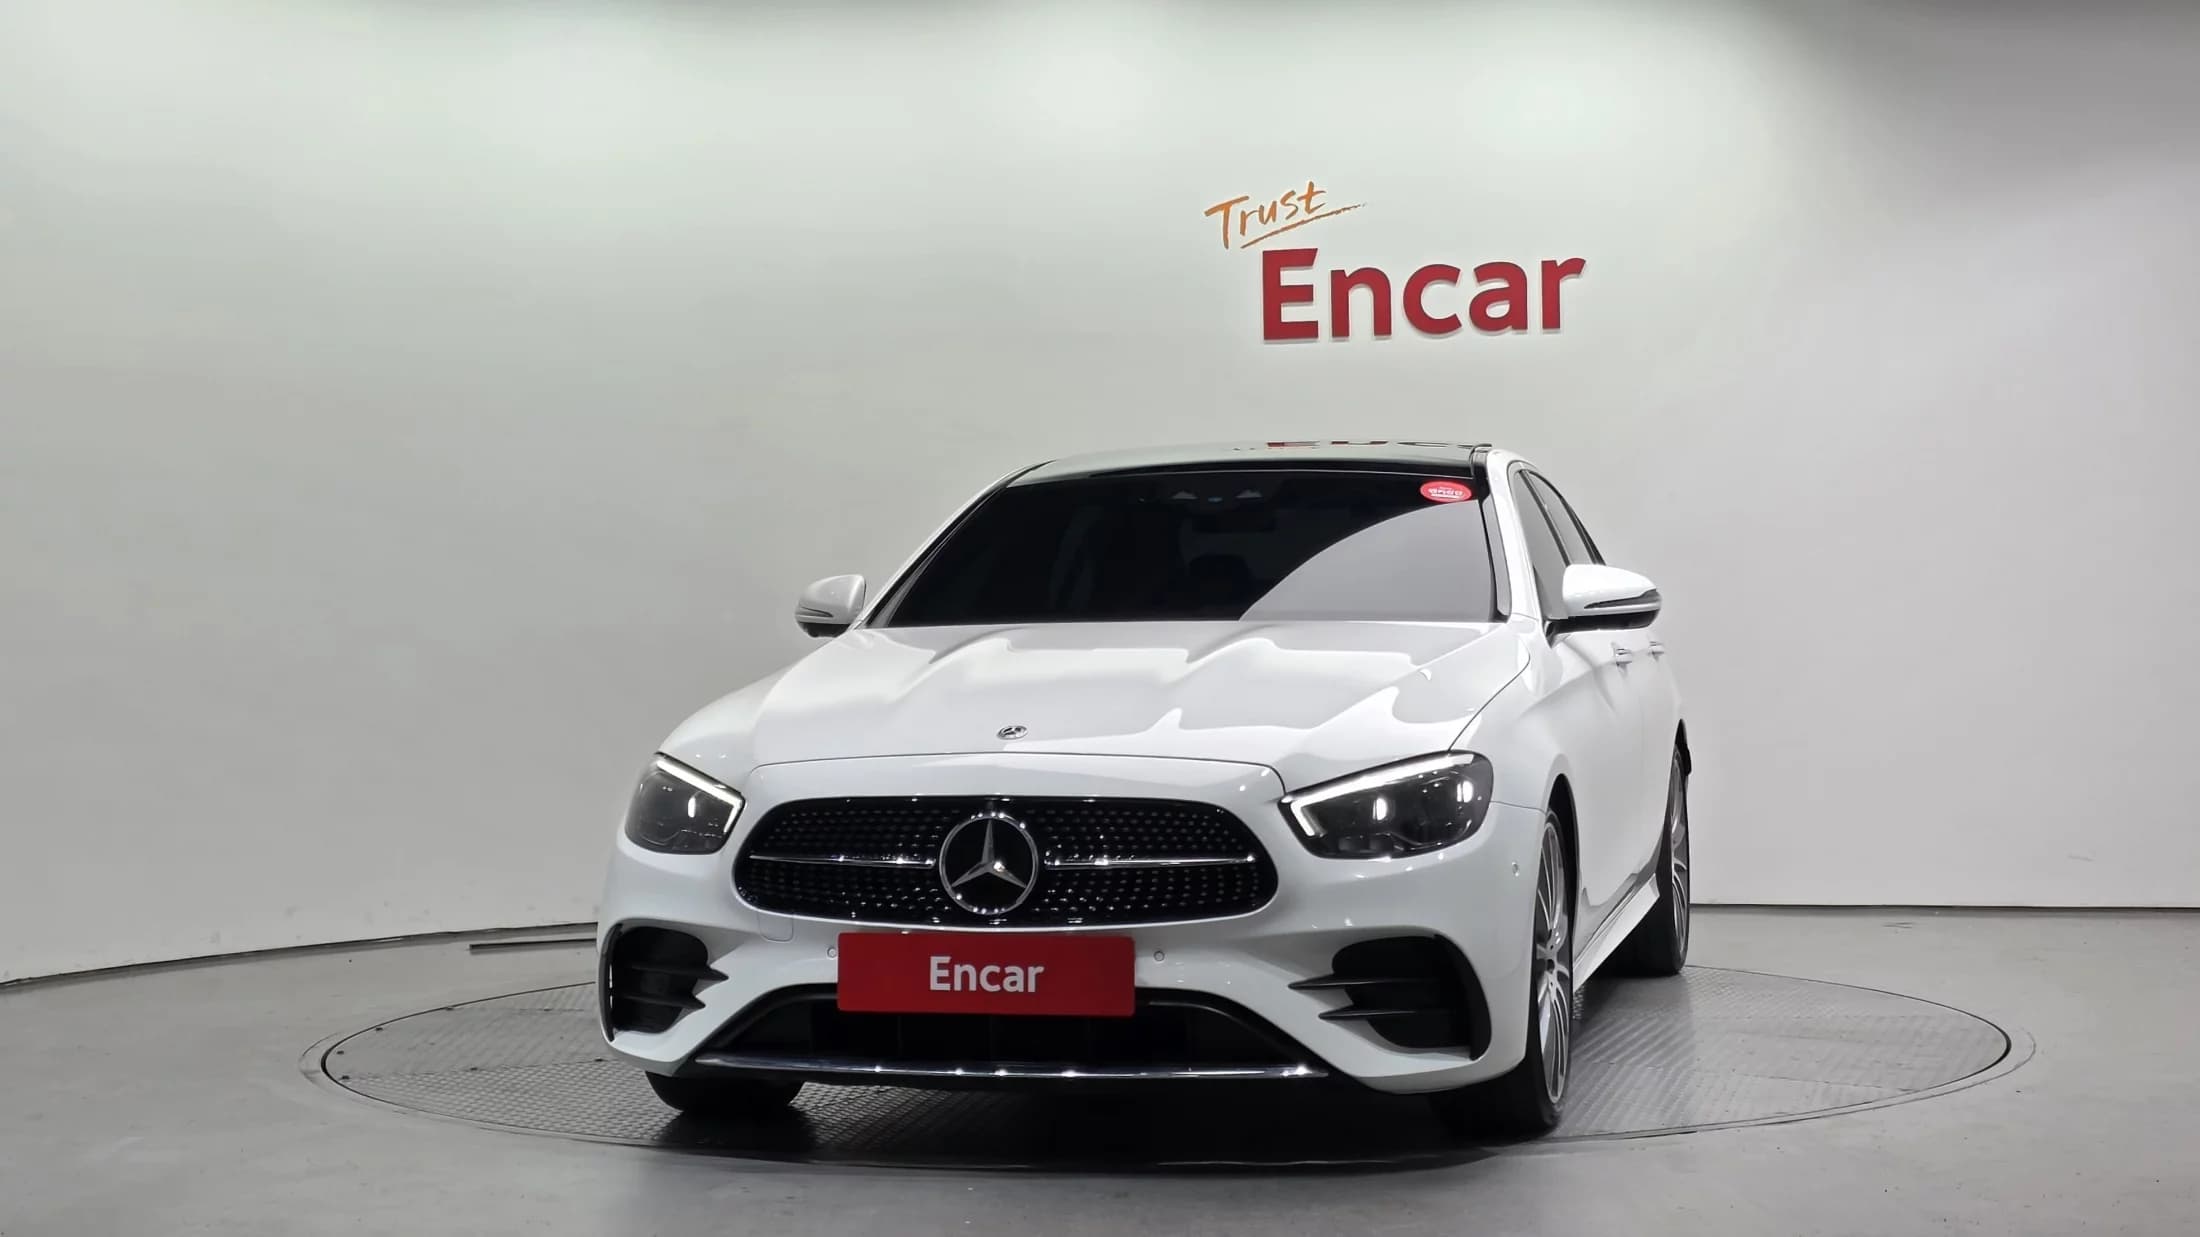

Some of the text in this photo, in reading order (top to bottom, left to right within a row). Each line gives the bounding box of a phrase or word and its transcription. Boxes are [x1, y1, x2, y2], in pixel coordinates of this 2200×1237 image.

[1204, 181, 1327, 249] Trust
[1262, 248, 1587, 341] Encar
[929, 955, 1045, 993] Encar
